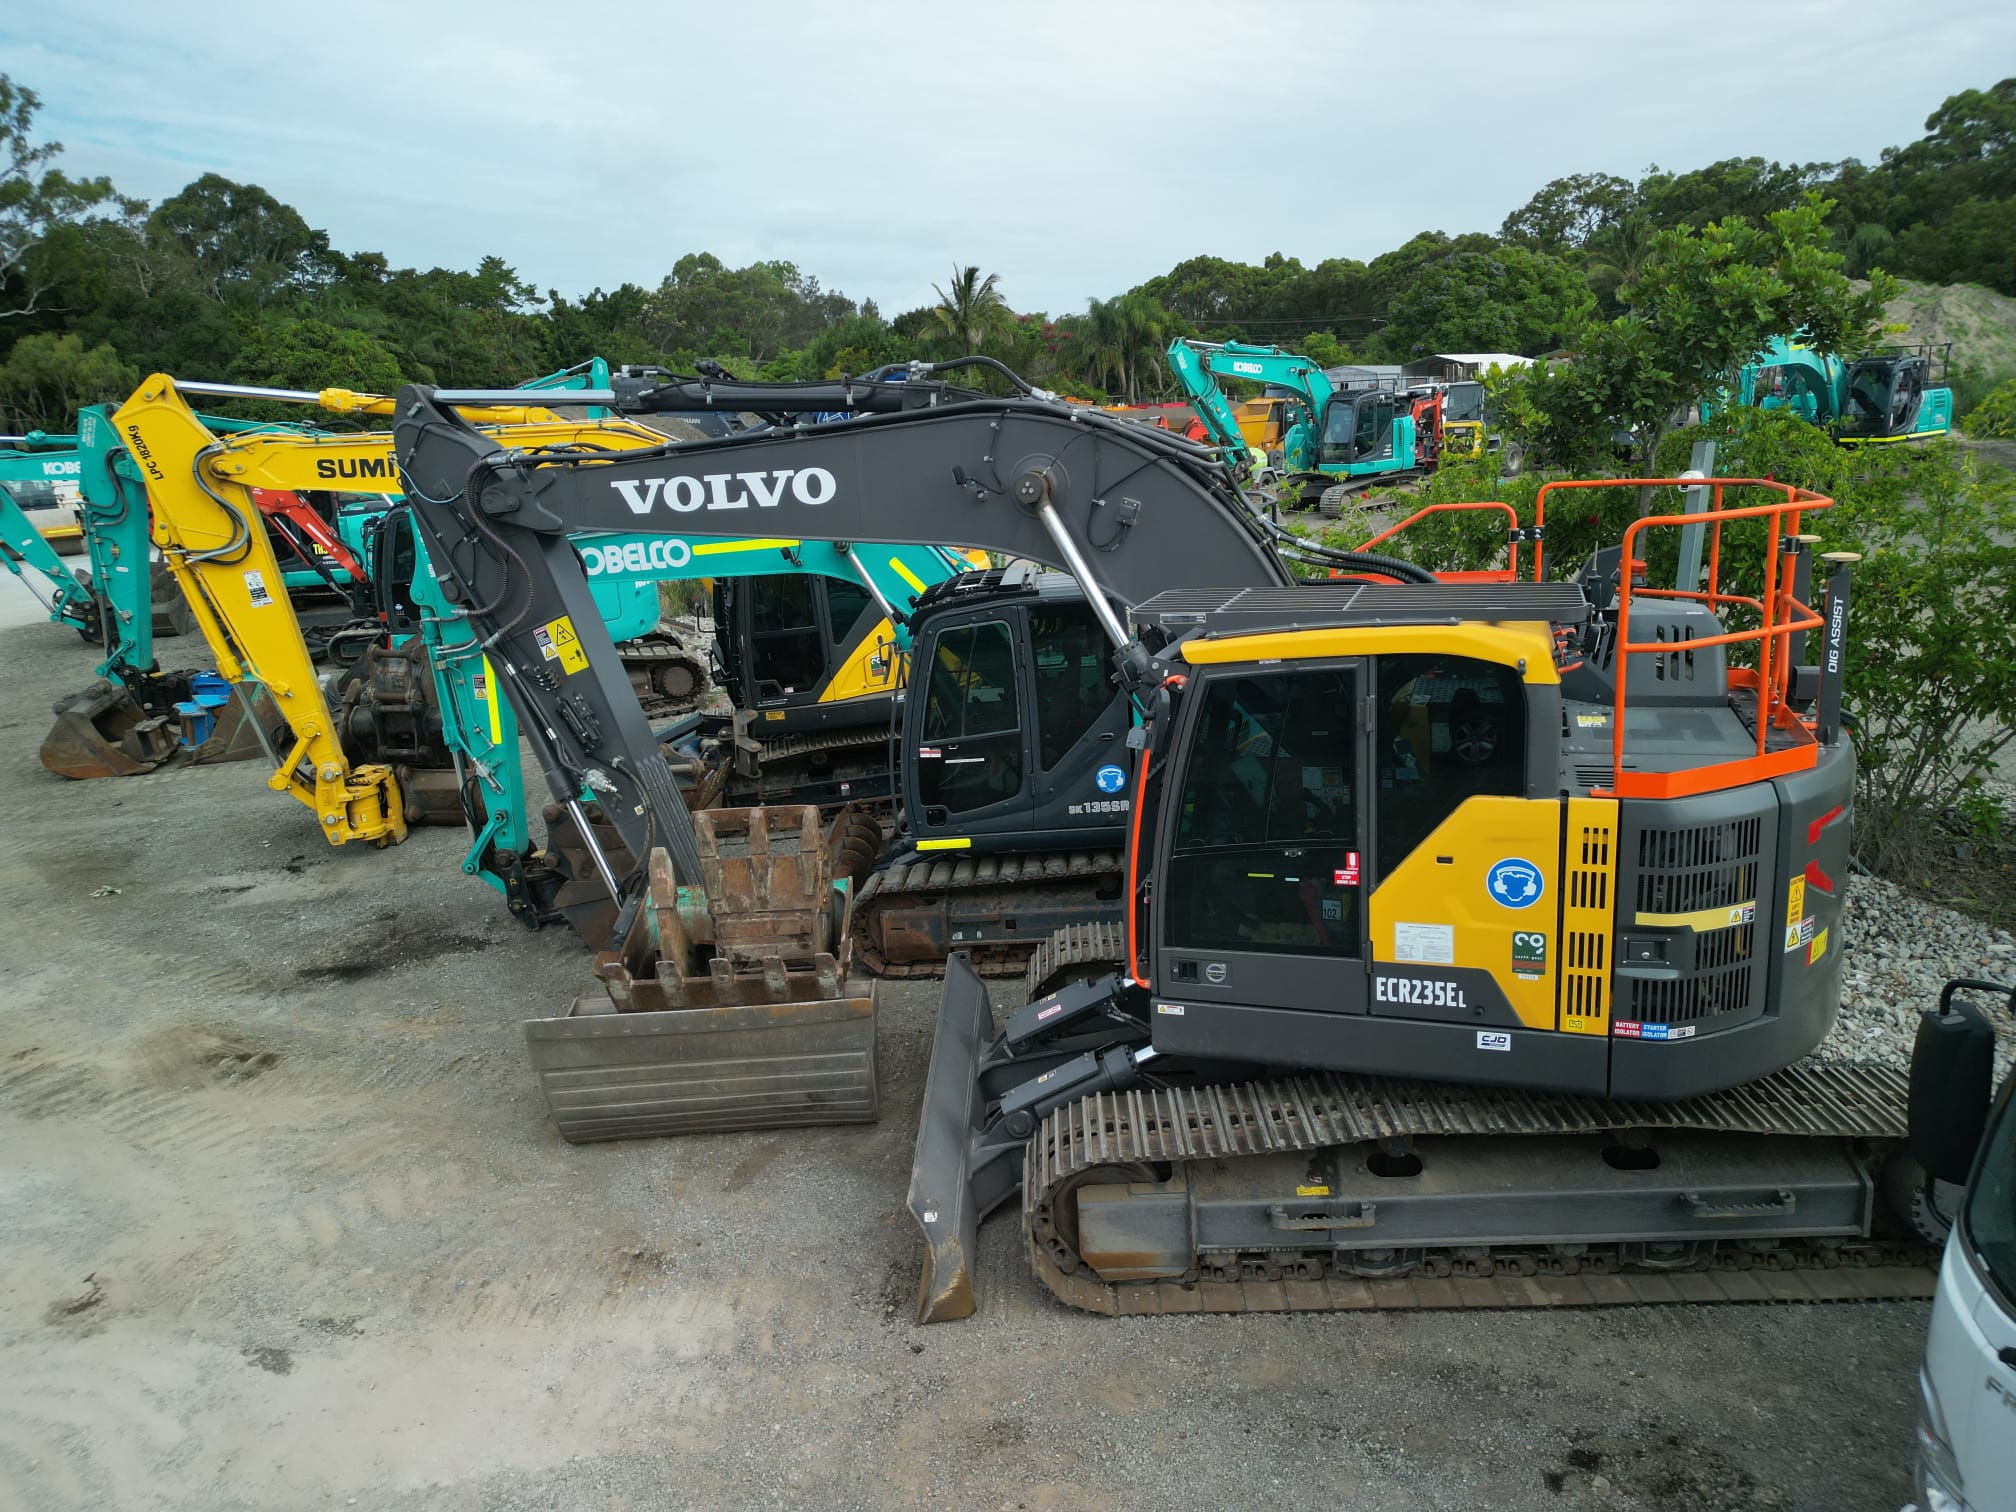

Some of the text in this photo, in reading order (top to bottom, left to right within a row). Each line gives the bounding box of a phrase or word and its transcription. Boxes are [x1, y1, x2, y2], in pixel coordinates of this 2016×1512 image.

[1233, 361, 1262, 374] KOBELCO
[146, 461, 164, 481] LPC
[610, 466, 836, 514] VOLVO
[578, 538, 691, 576] OBELCO
[1827, 595, 1844, 673] DIG ASSIST
[1068, 799, 1130, 815] SK135SR
[1614, 1028, 1640, 1037] ISOLATOR
[1615, 1021, 1640, 1030] BATTERY
